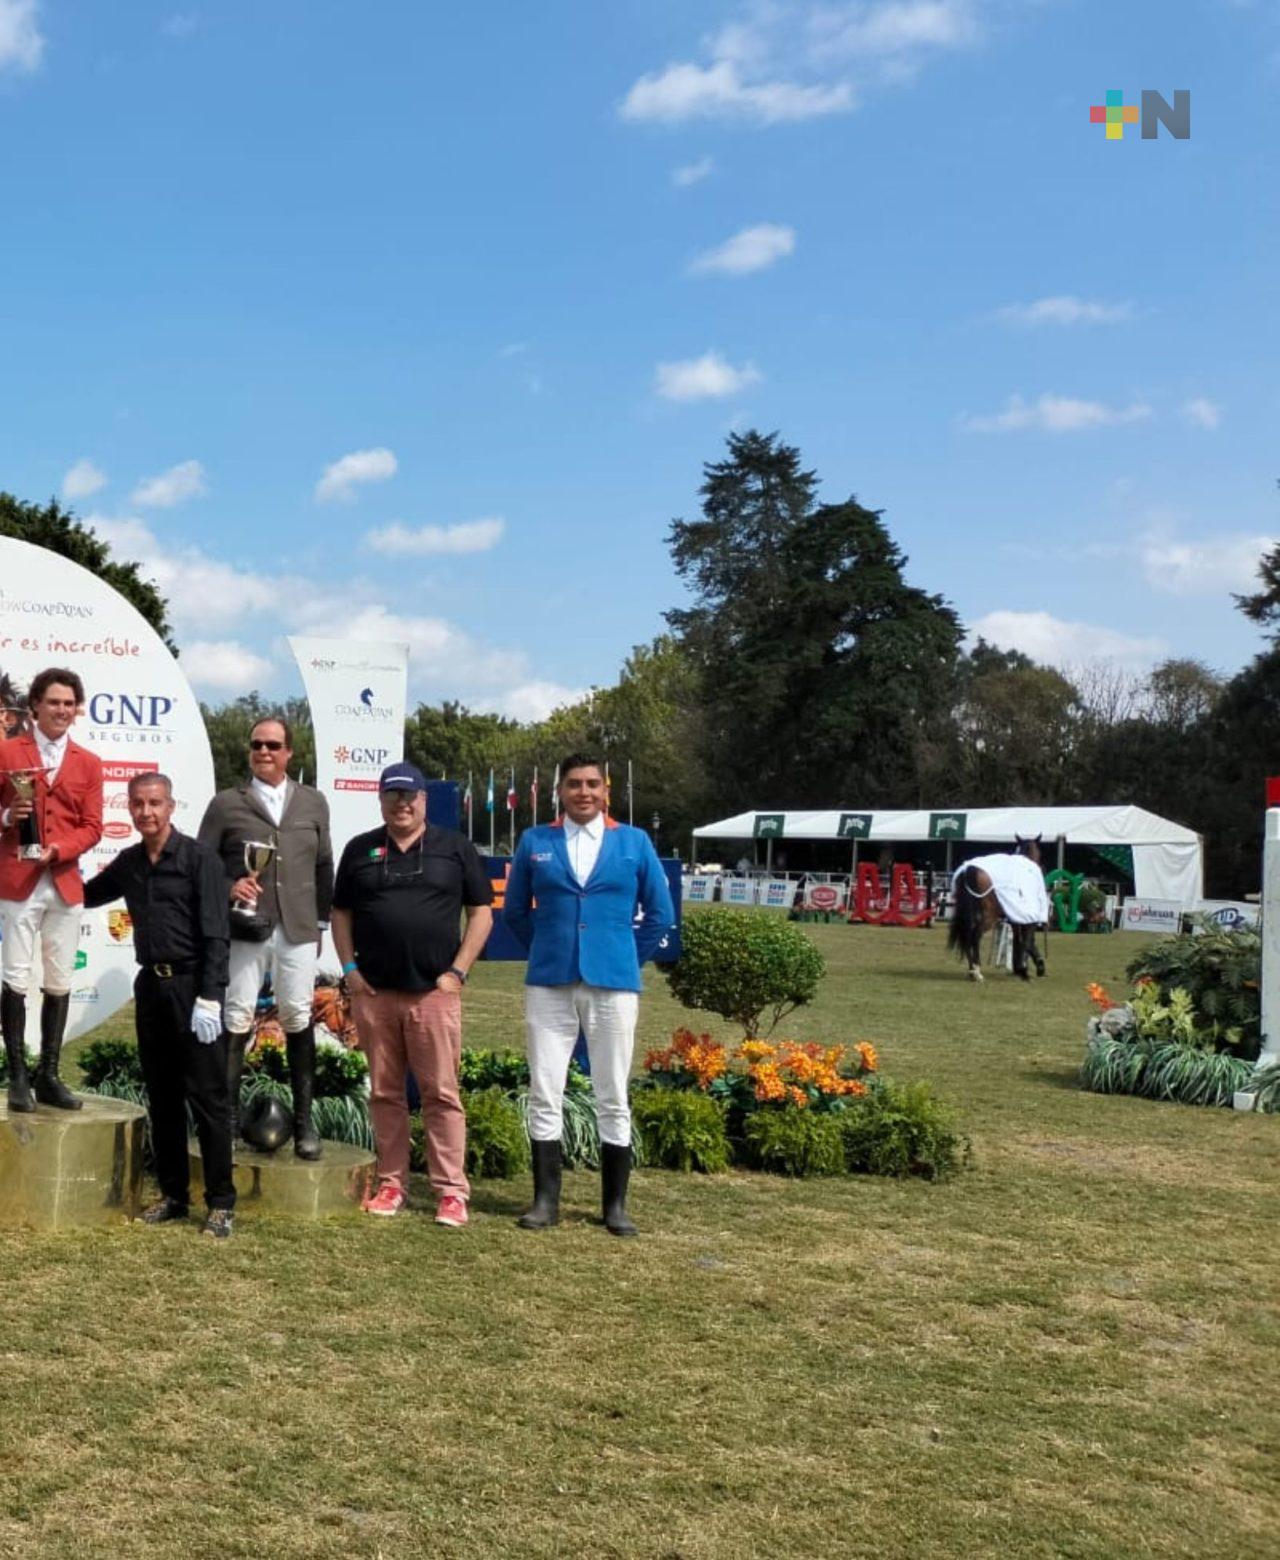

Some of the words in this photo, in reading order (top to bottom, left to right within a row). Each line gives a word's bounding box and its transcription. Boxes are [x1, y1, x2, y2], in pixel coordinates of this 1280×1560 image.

[20, 637, 39, 651] es
[47, 633, 140, 656] increíble
[89, 692, 173, 726] GNP
[89, 731, 172, 743] SEGUROS
[351, 748, 389, 765] GNP
